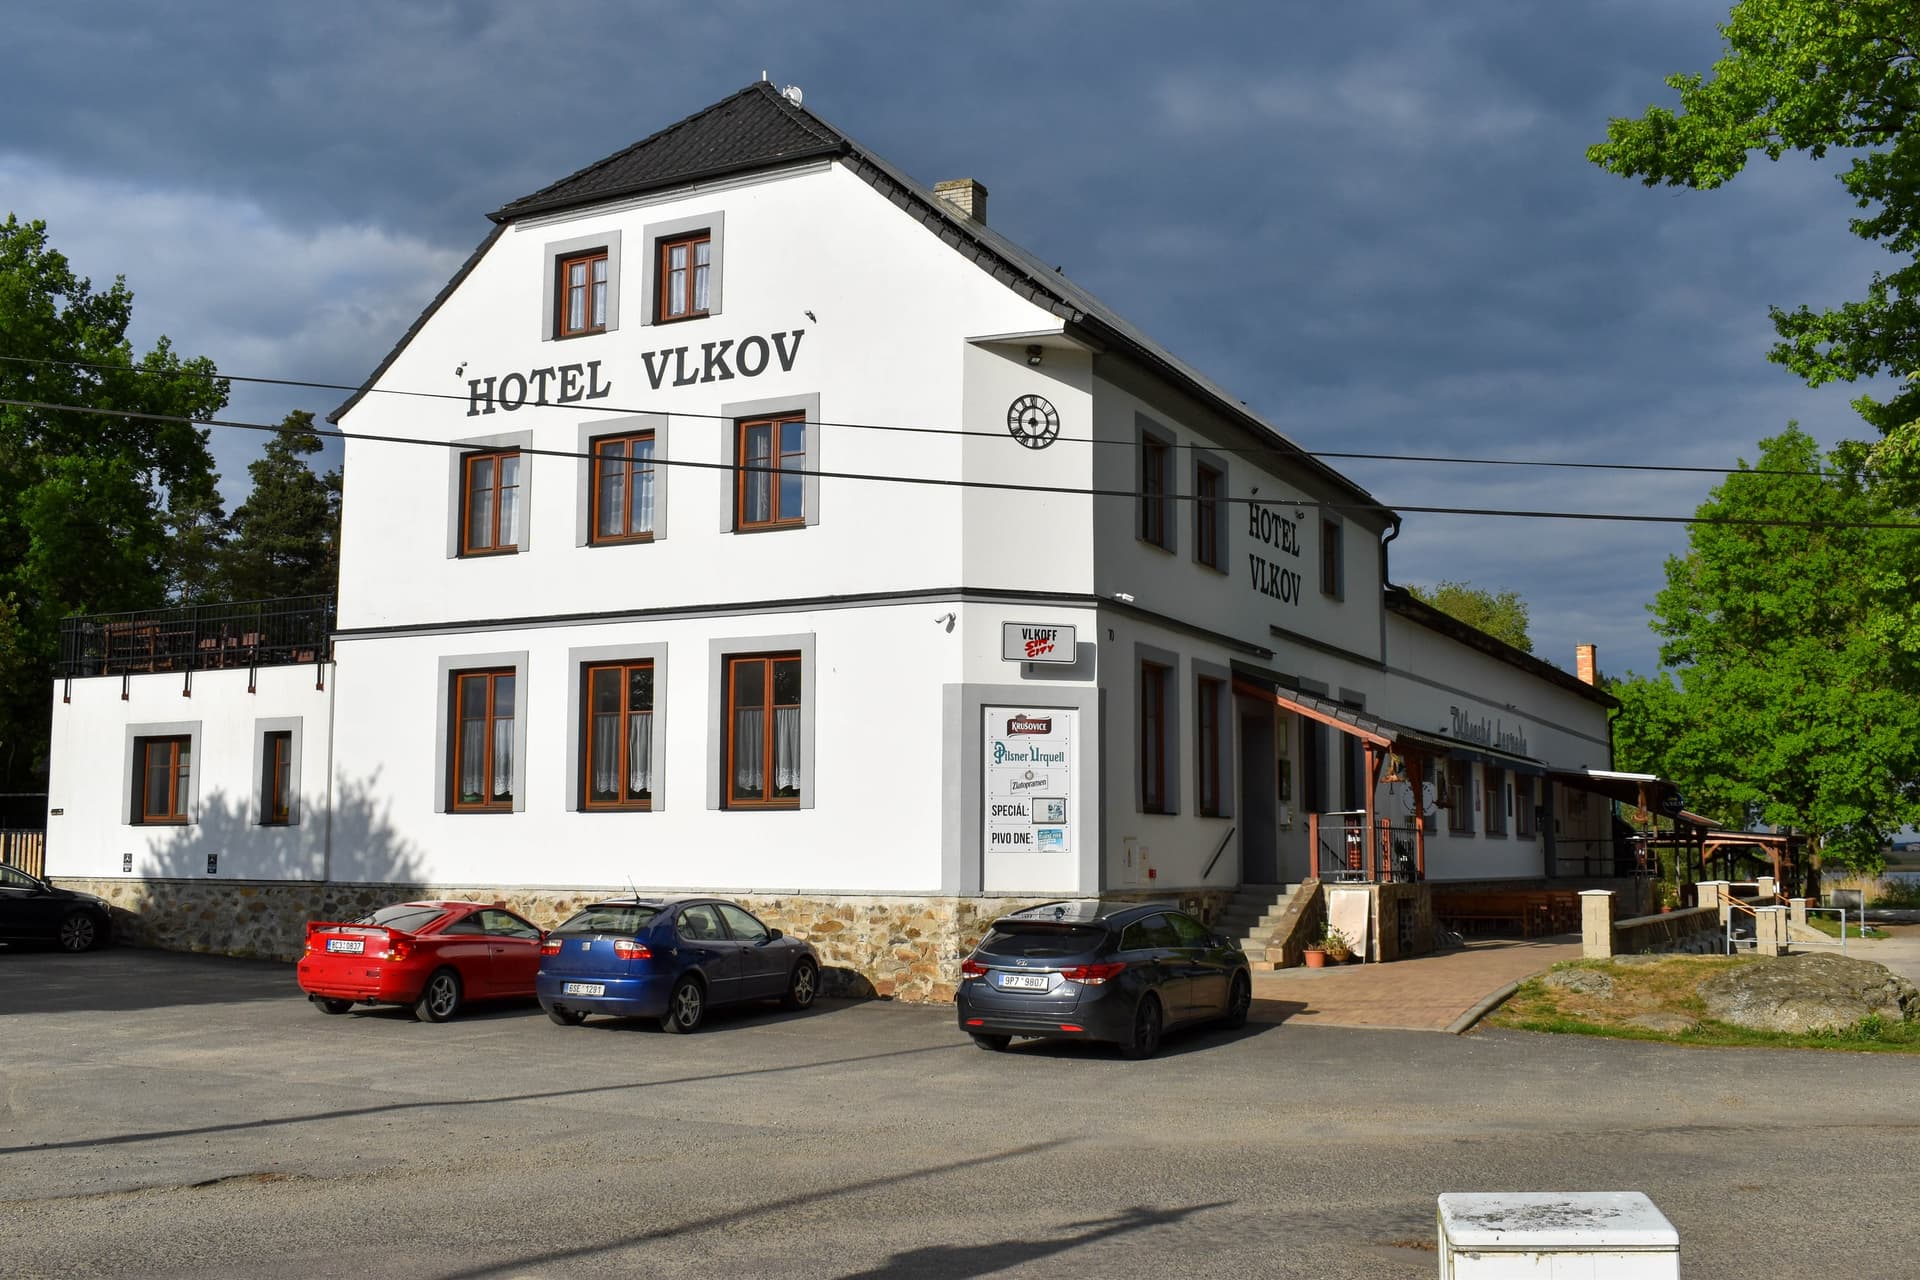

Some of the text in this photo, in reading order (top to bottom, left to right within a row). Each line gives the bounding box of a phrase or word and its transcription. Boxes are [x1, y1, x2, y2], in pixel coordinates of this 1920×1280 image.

[466, 329, 805, 416] HOTEL VLKOV
[1248, 502, 1300, 557] HOTEL
[1249, 553, 1301, 607] VLKOV
[1022, 628, 1057, 640] VLKOFF
[1027, 644, 1055, 658] CITY
[993, 741, 1065, 767] Pilsner Urquell
[991, 802, 1029, 817] SPECIÁL:
[991, 832, 1012, 844] PIVO
[1013, 832, 1033, 844] DNE:
[1005, 976, 1019, 986] 9P7
